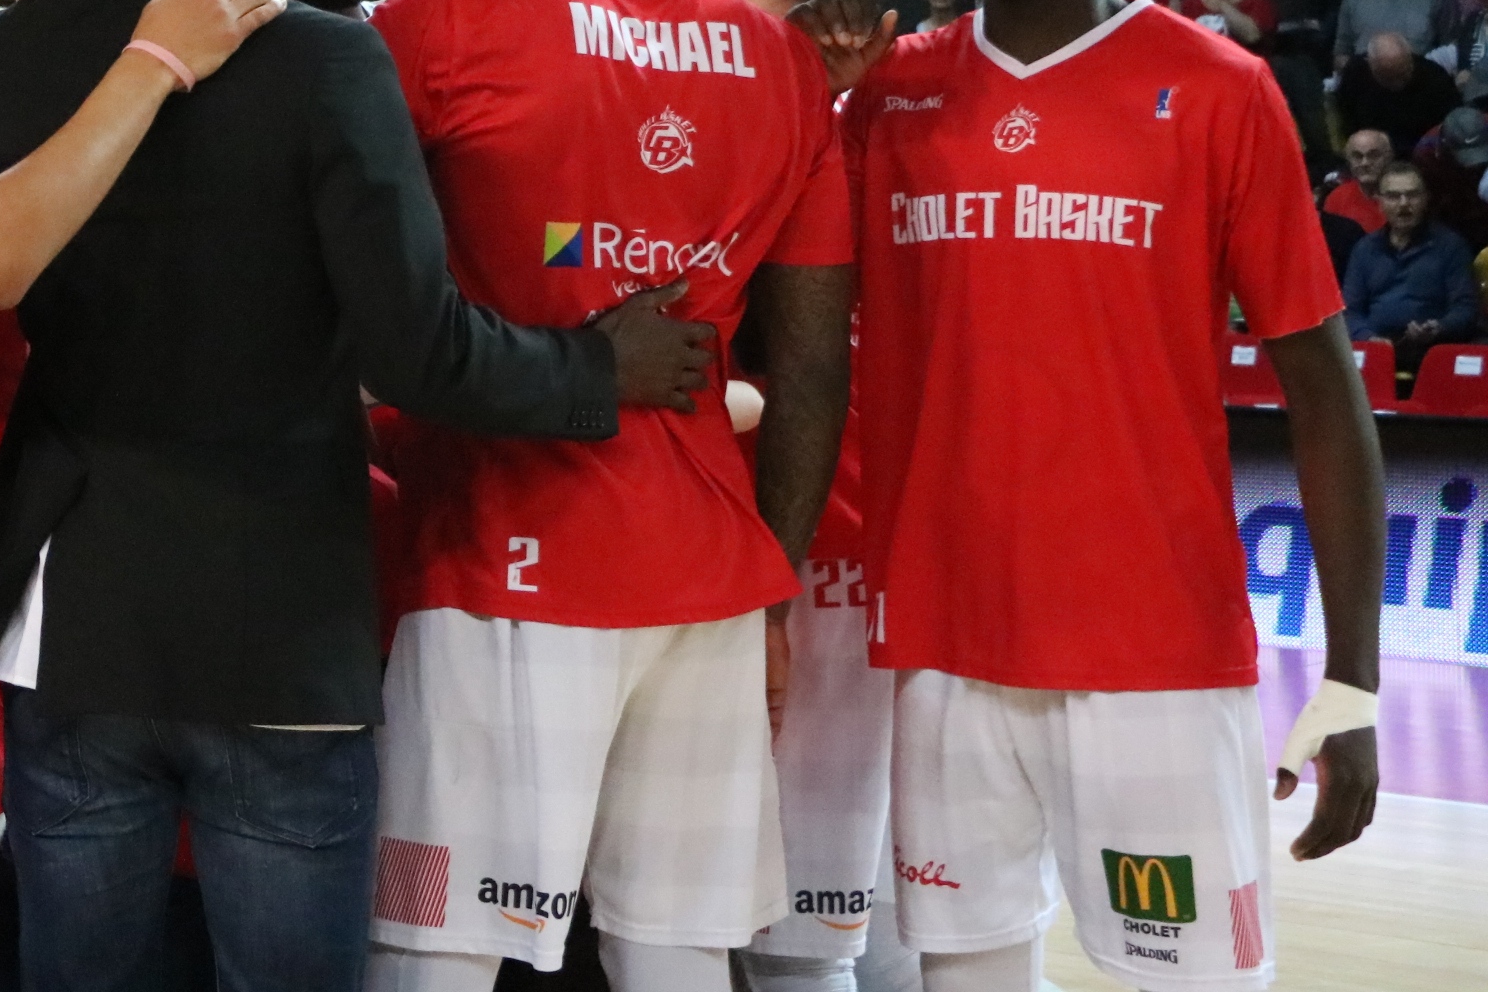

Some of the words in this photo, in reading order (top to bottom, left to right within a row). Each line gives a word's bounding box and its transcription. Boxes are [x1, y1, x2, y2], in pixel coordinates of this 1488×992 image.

[568, 1, 756, 78] MICHAEL
[891, 192, 1002, 244] CHOLET
[1015, 184, 1164, 248] BASKET
[506, 536, 540, 593] 2
[1123, 919, 1181, 939] CHOLET
[1124, 940, 1179, 965] SPALDING
